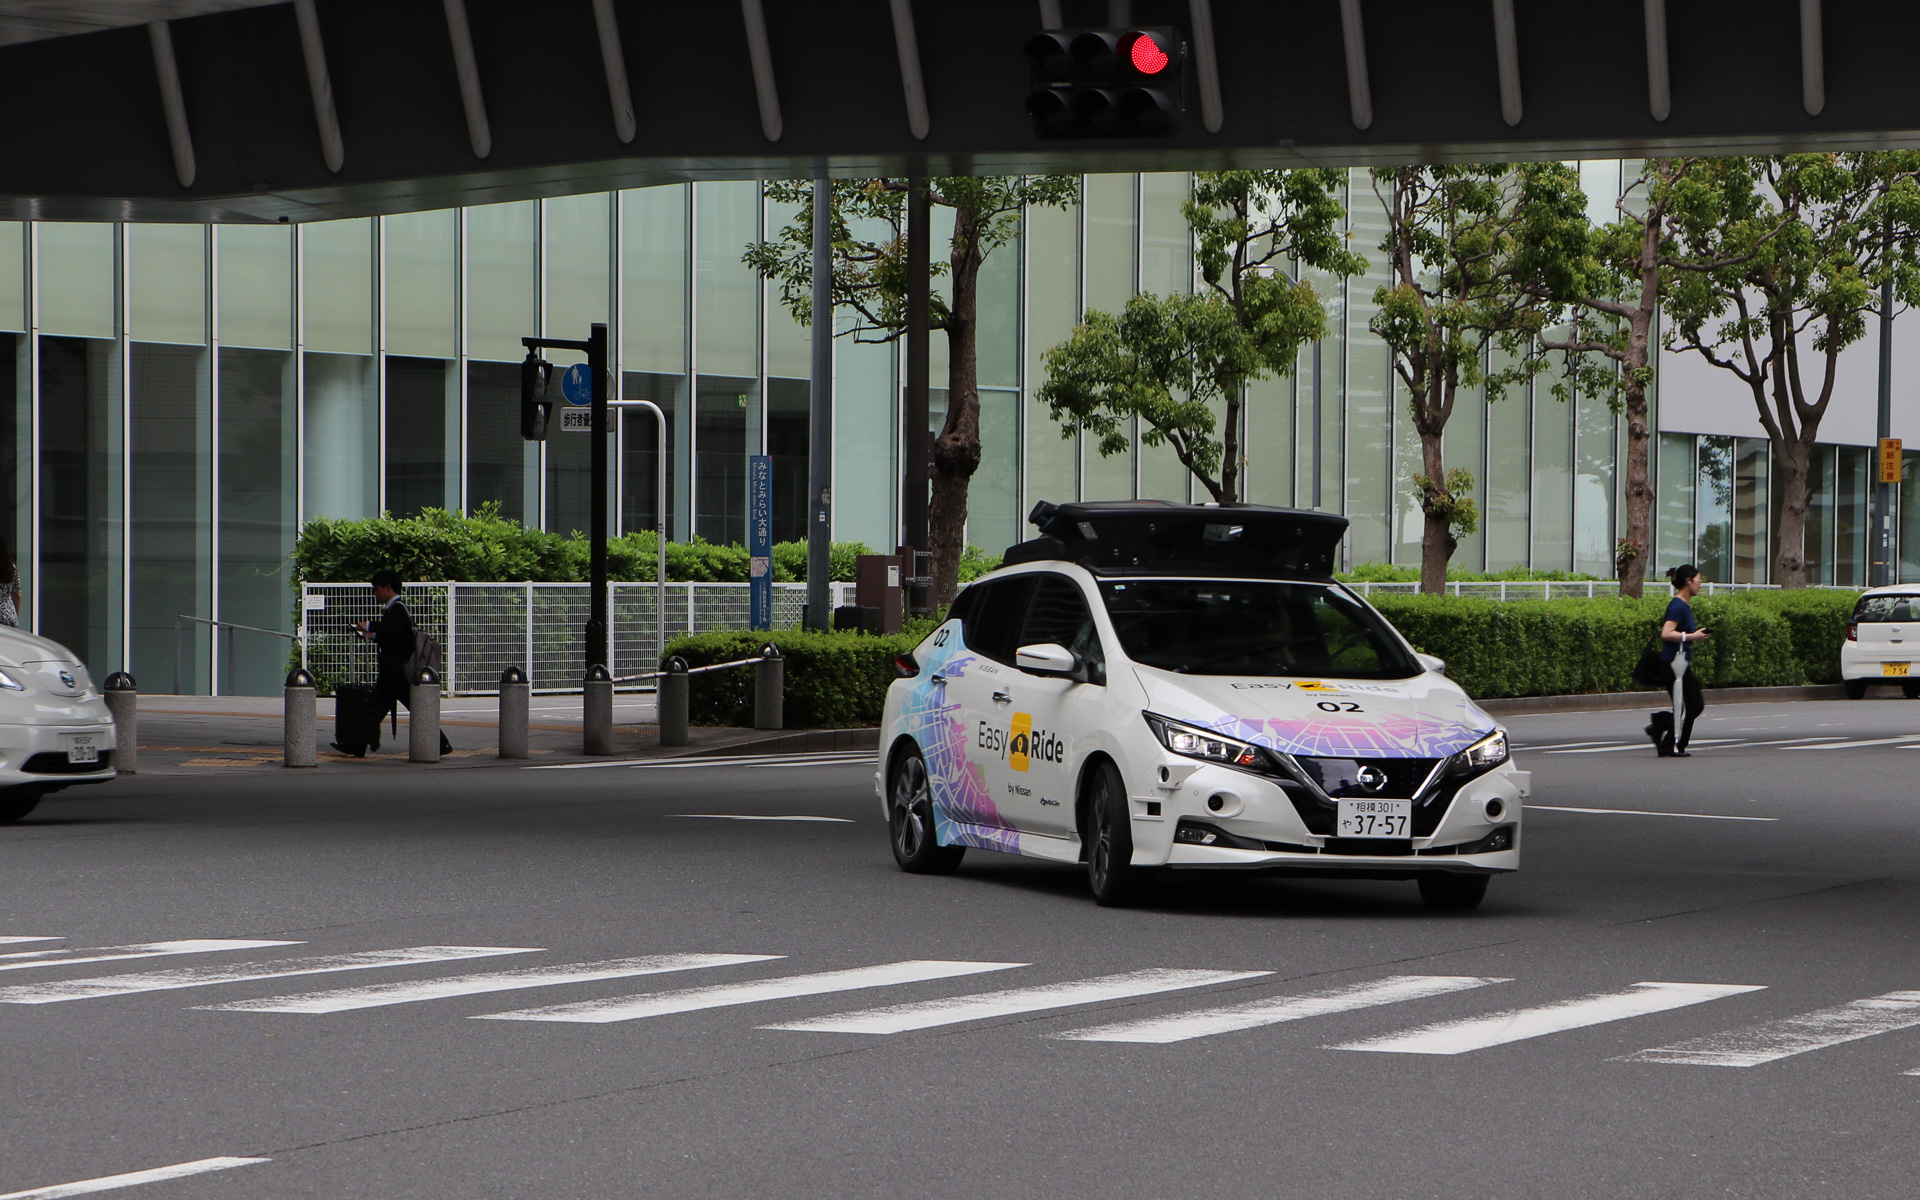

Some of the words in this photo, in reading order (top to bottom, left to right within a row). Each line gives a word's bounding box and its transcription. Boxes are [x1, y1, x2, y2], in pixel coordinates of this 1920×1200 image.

[563, 413, 592, 427] 歩行者優
[758, 462, 767, 547] みなとみらい大通り
[934, 629, 950, 647] 02
[1339, 683, 1401, 693] Ride
[1317, 701, 1364, 713] 02
[979, 720, 1009, 760] Easy
[1031, 730, 1063, 763] Ride
[1008, 783, 1015, 796] by
[1015, 785, 1032, 797] Nissan
[1354, 814, 1407, 836] 37-57
